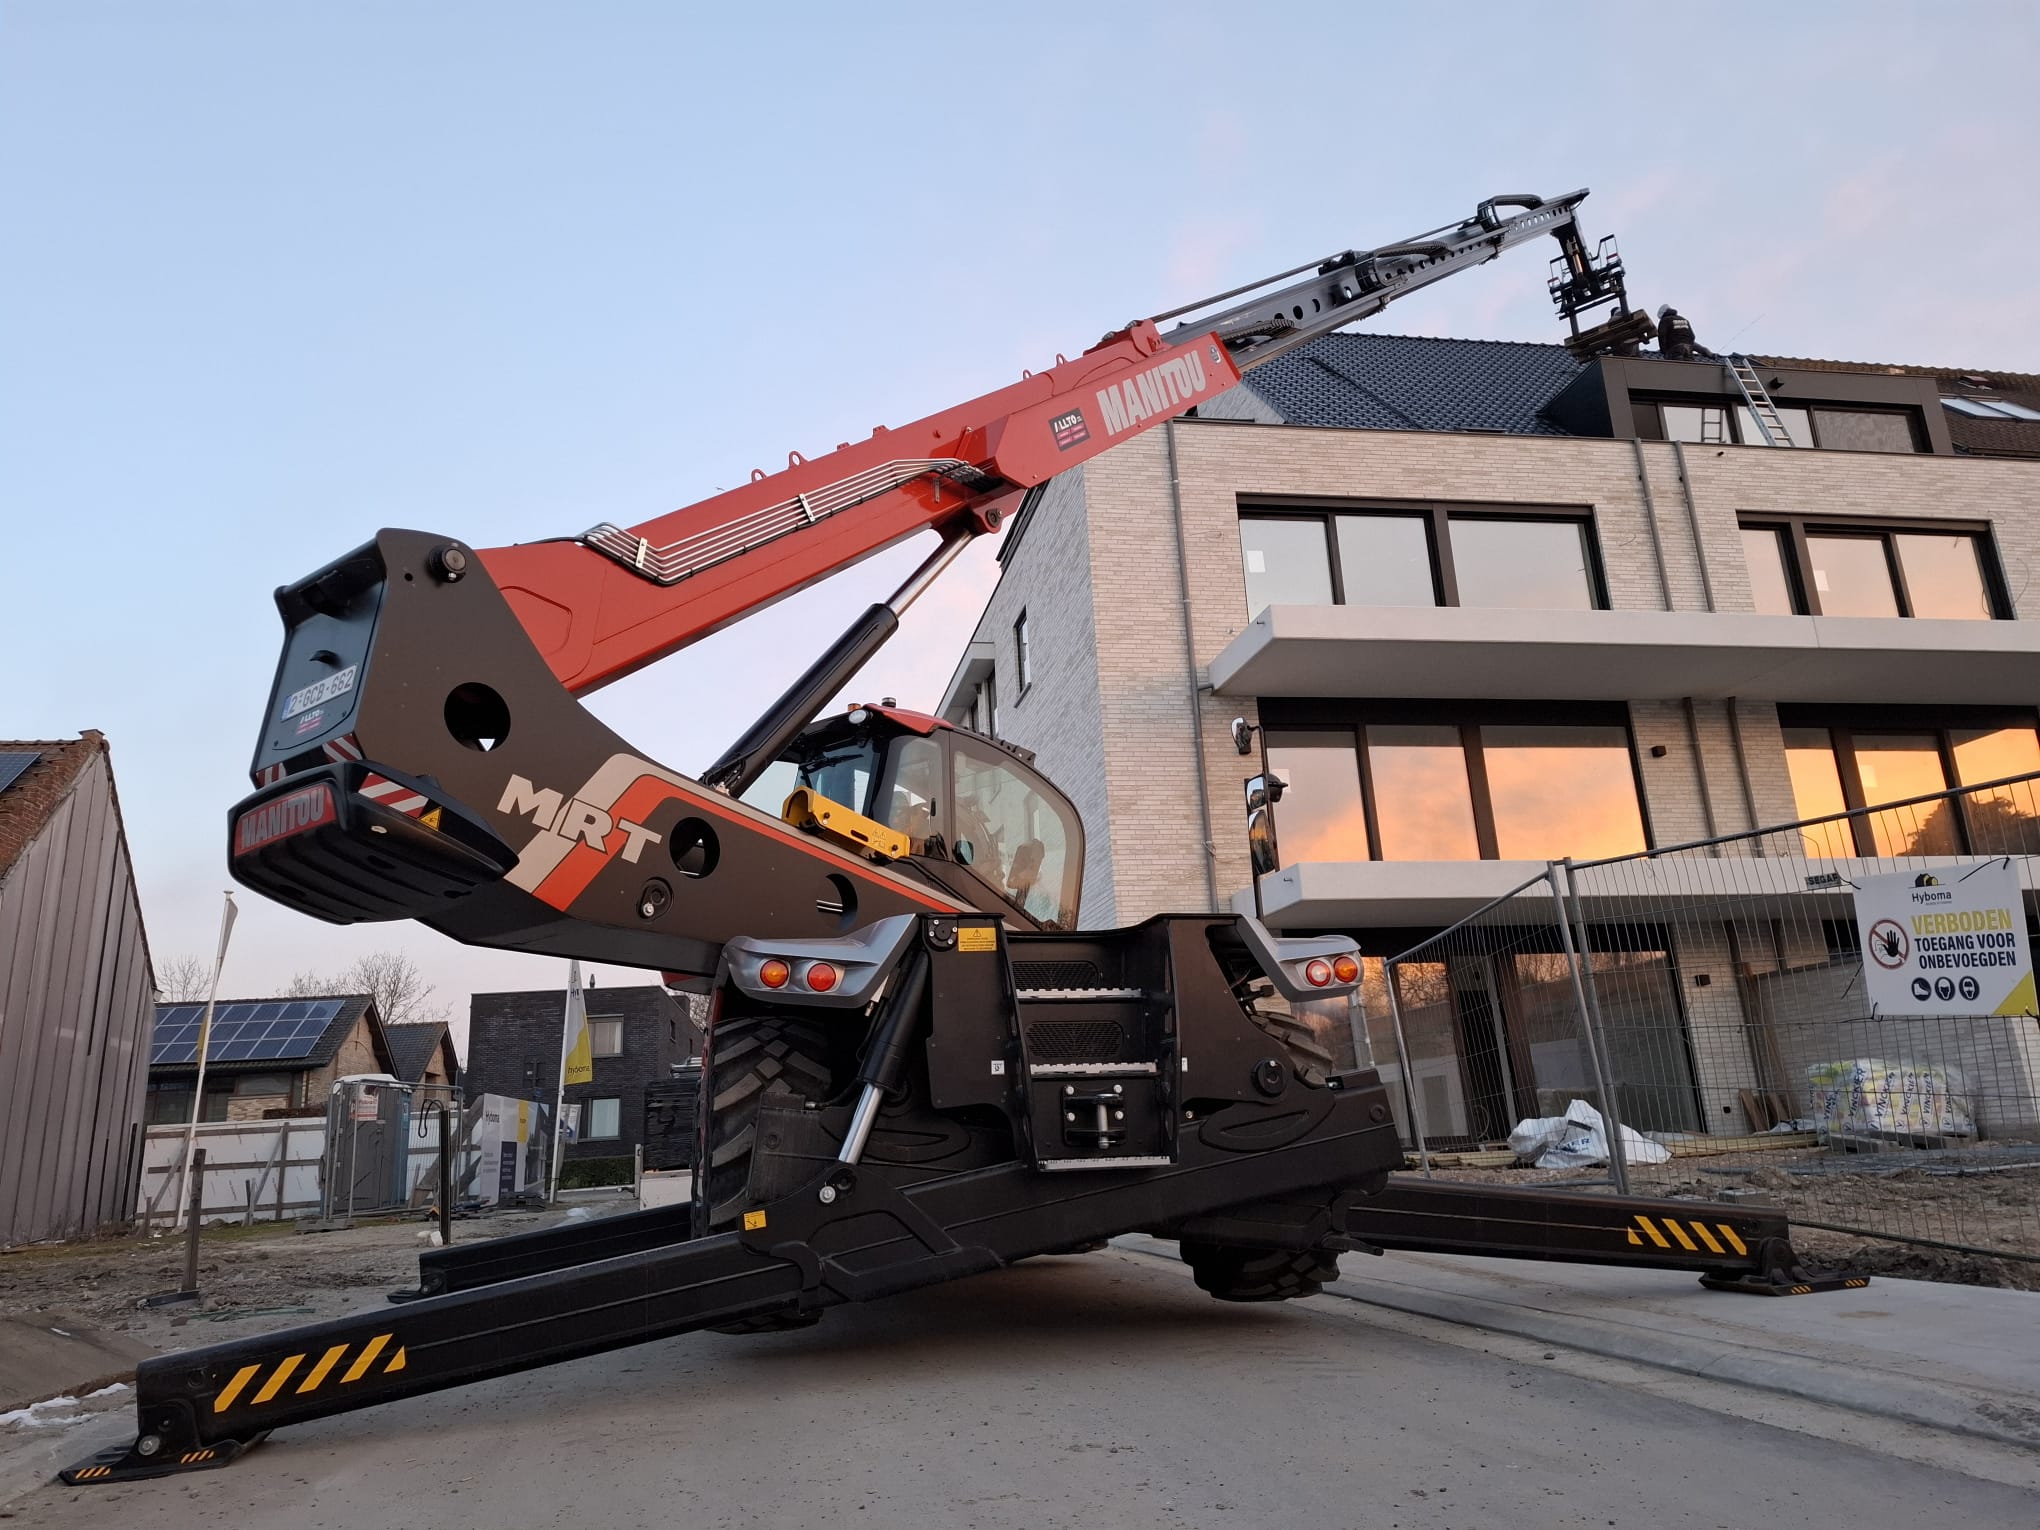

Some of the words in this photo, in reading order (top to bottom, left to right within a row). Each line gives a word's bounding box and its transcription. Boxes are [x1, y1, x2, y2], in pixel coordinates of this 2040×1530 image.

[1096, 350, 1206, 436] MANITOU
[242, 786, 324, 849] MANITOU
[497, 773, 662, 864] MRT
[1912, 891, 1952, 904] Hyboma
[1911, 908, 2012, 935] VERBODEN
[1914, 934, 1974, 952] TOEGANG
[1976, 932, 2016, 948] VOOR
[1919, 951, 2016, 969] ONBEVOEGDEN
